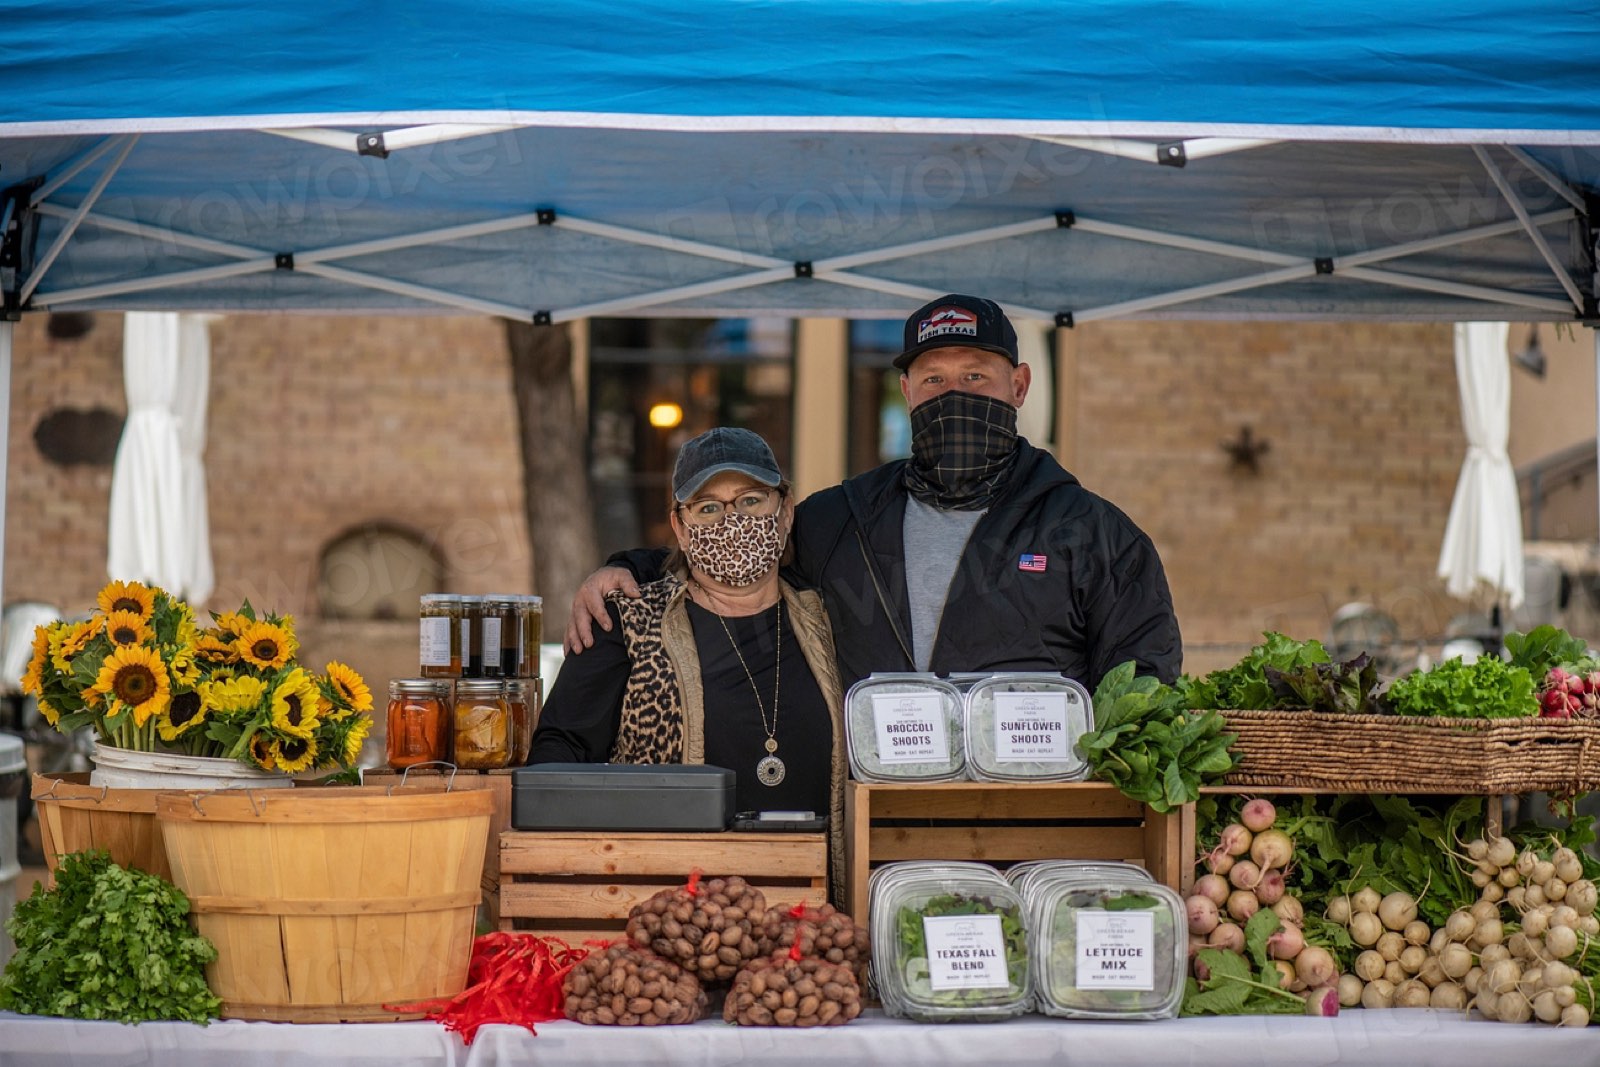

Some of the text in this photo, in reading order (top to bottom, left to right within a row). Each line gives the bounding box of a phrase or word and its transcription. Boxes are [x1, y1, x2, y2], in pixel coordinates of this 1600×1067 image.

[942, 326, 975, 335] TEXAS
[886, 723, 934, 733] BROCCOLI
[1000, 721, 1062, 731] SUNFLOWER
[891, 735, 932, 747] SHOOTS
[1011, 734, 1052, 744] SHOOTS
[936, 948, 997, 959] TEXAS FALL
[1085, 948, 1144, 957] LETTUCE
[951, 961, 985, 971] BLEND
[1100, 960, 1127, 971] MIX
